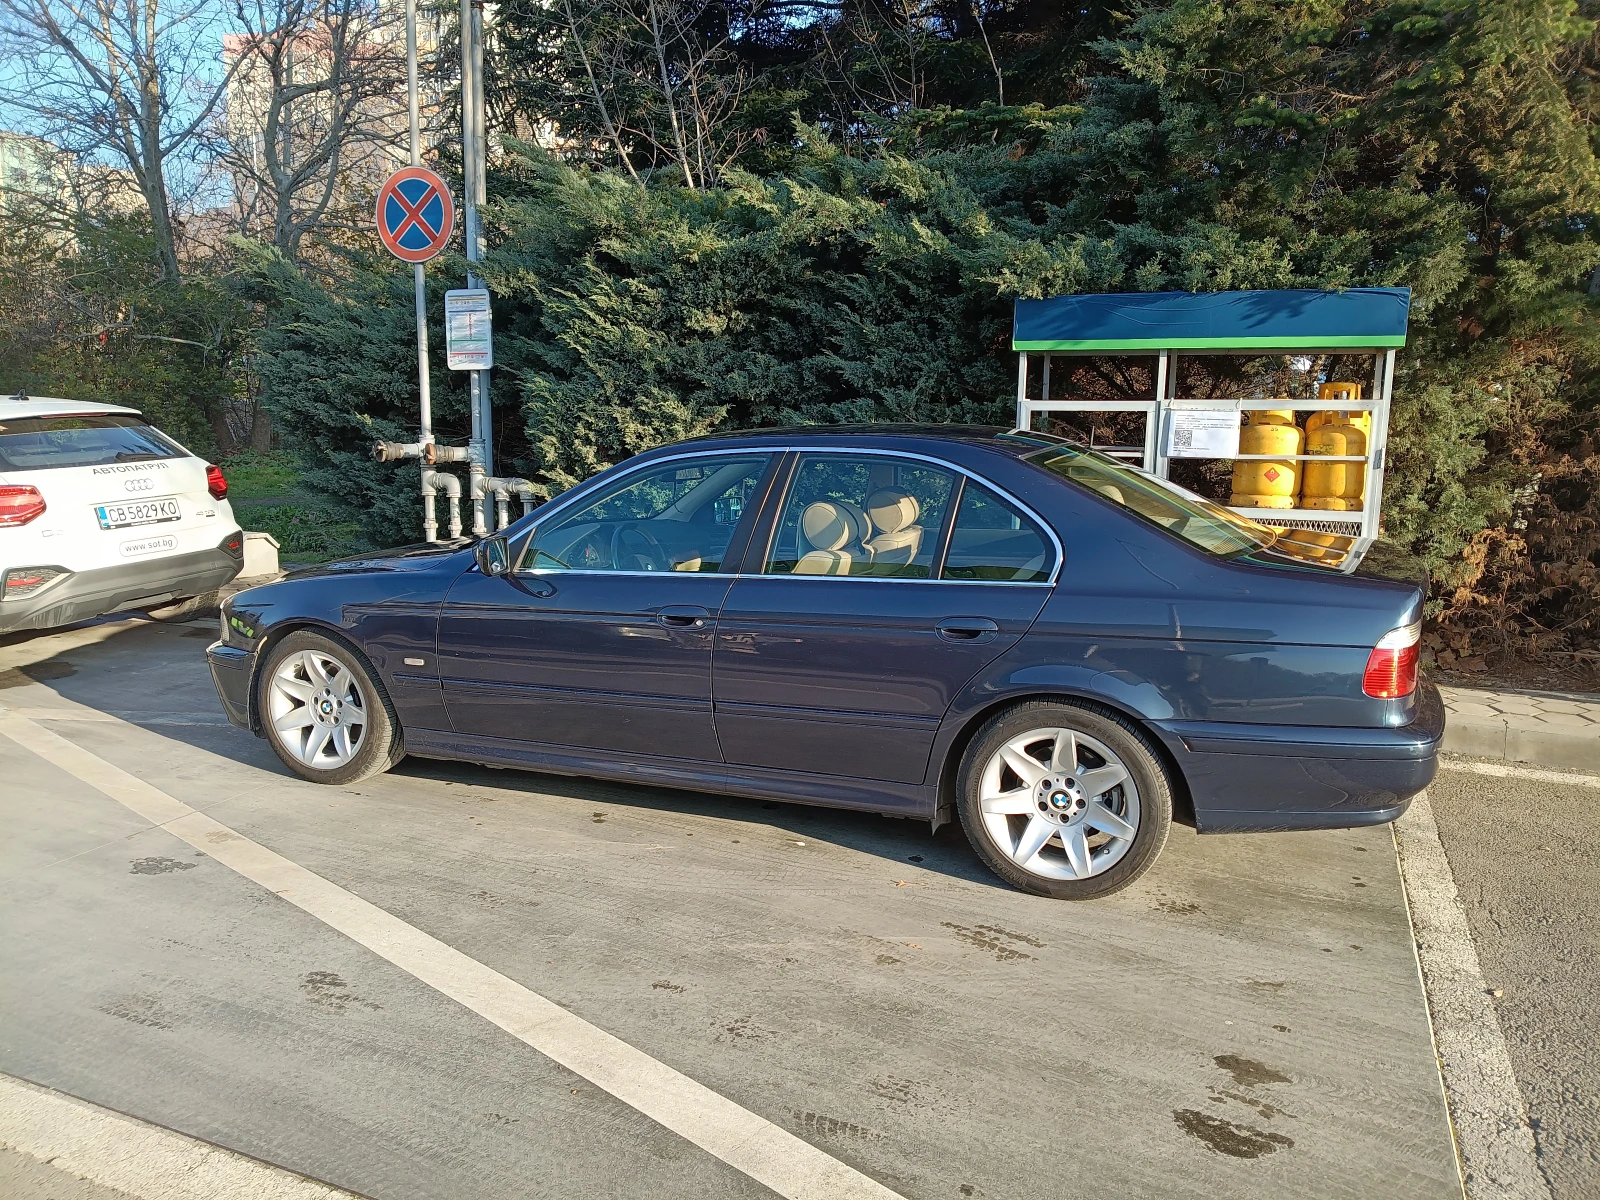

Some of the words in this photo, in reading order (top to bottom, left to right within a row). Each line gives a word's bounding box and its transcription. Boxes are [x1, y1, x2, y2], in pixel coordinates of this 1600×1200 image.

[92, 462, 169, 475] АВТОПАТРУЛ
[127, 504, 158, 519] 5829
[125, 539, 173, 551] www.sot.bg
